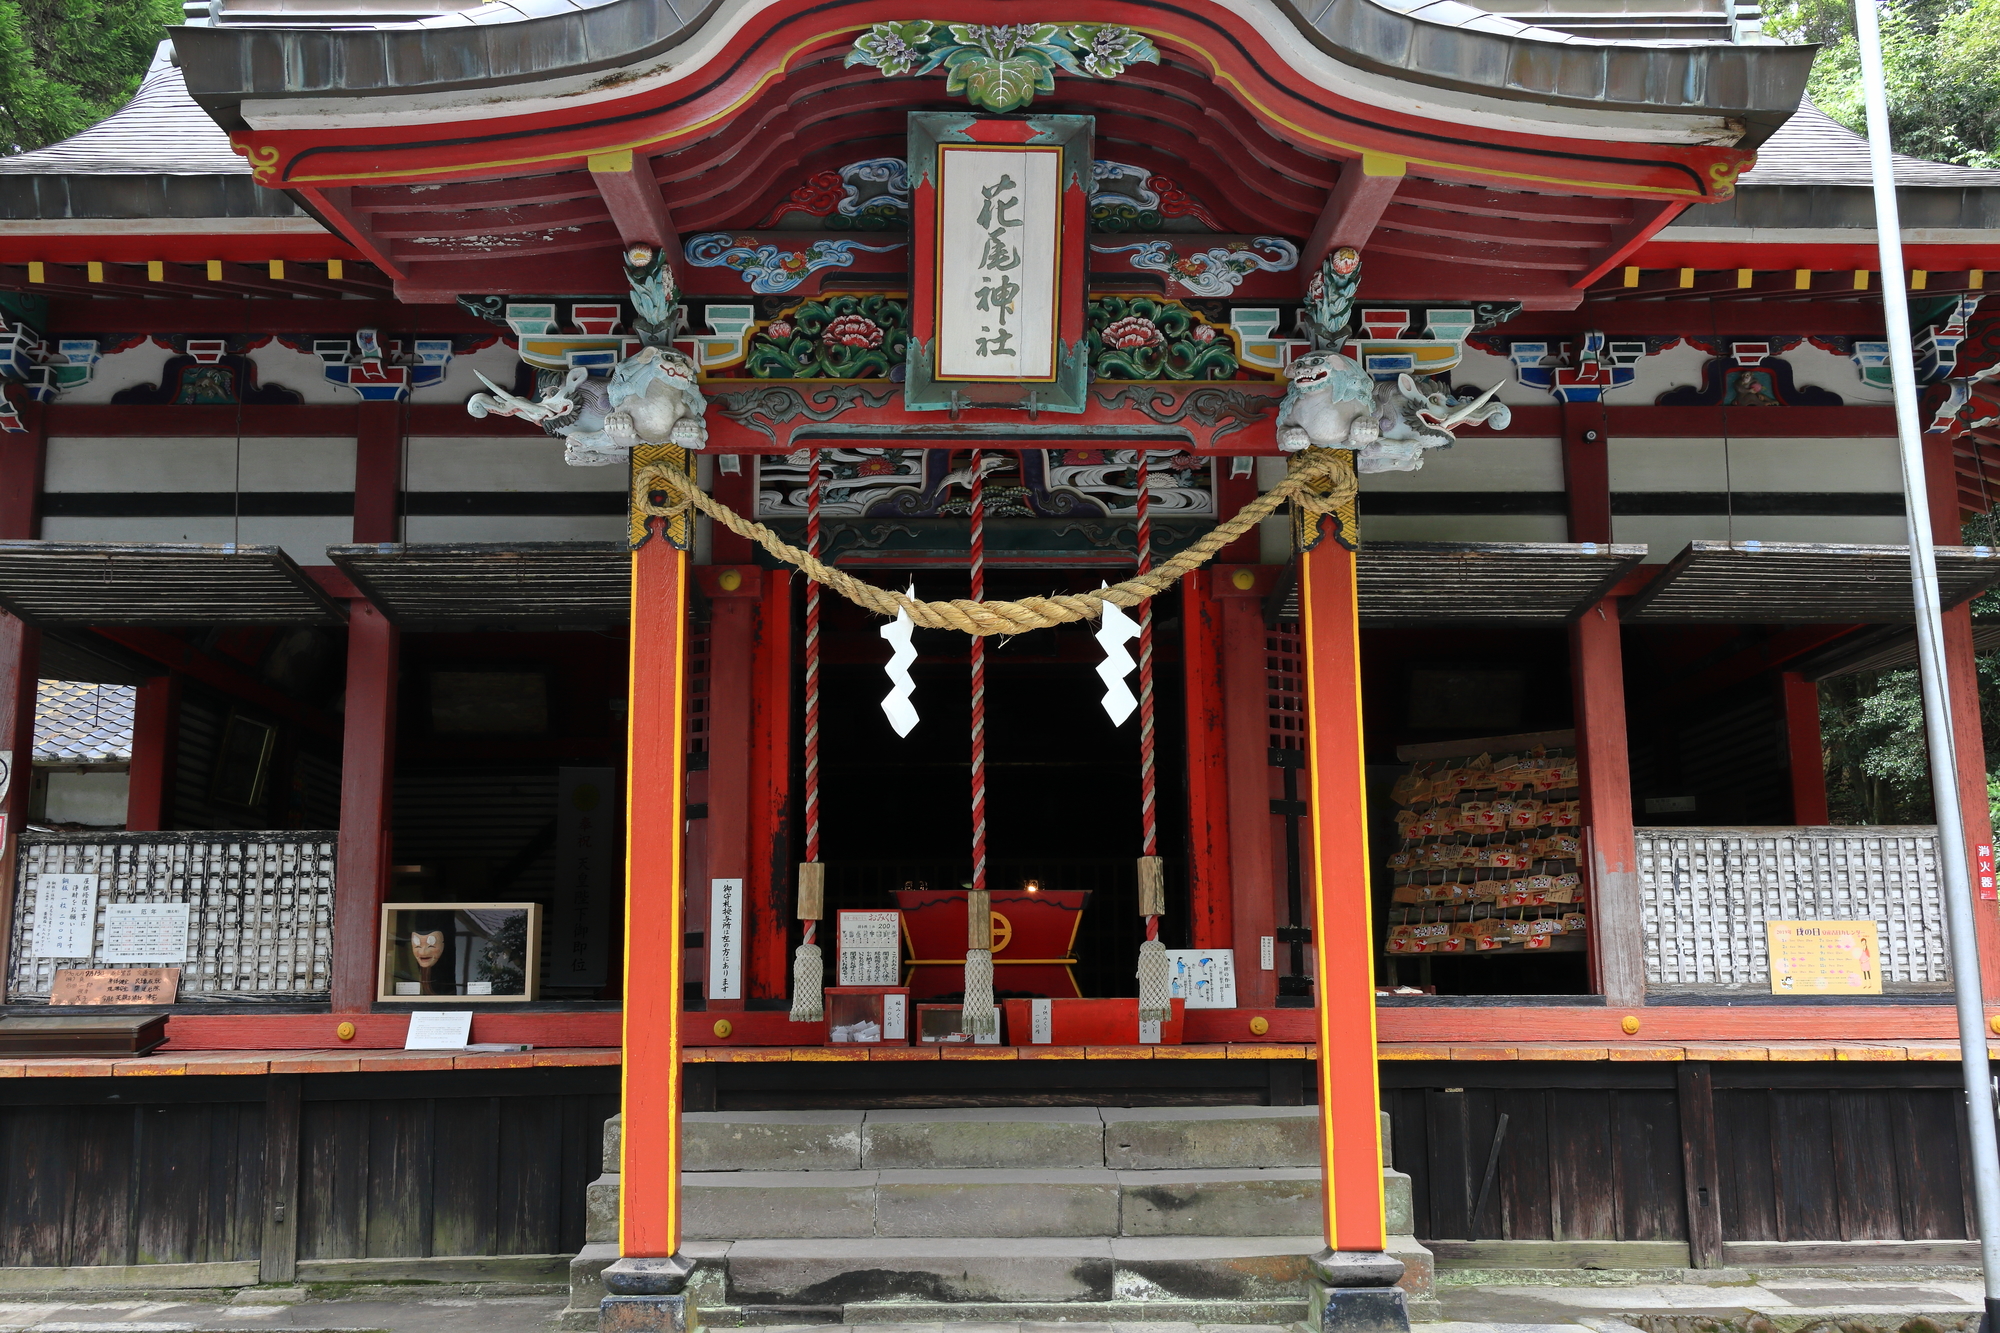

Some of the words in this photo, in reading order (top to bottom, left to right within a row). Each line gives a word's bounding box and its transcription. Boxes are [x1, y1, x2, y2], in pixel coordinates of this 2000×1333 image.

[975, 174, 1024, 357] 花尾神社
[1978, 845, 1993, 888] 消火器
[721, 884, 733, 993] 御守札授与所は左の方にあります
[868, 913, 898, 922] おみくじ
